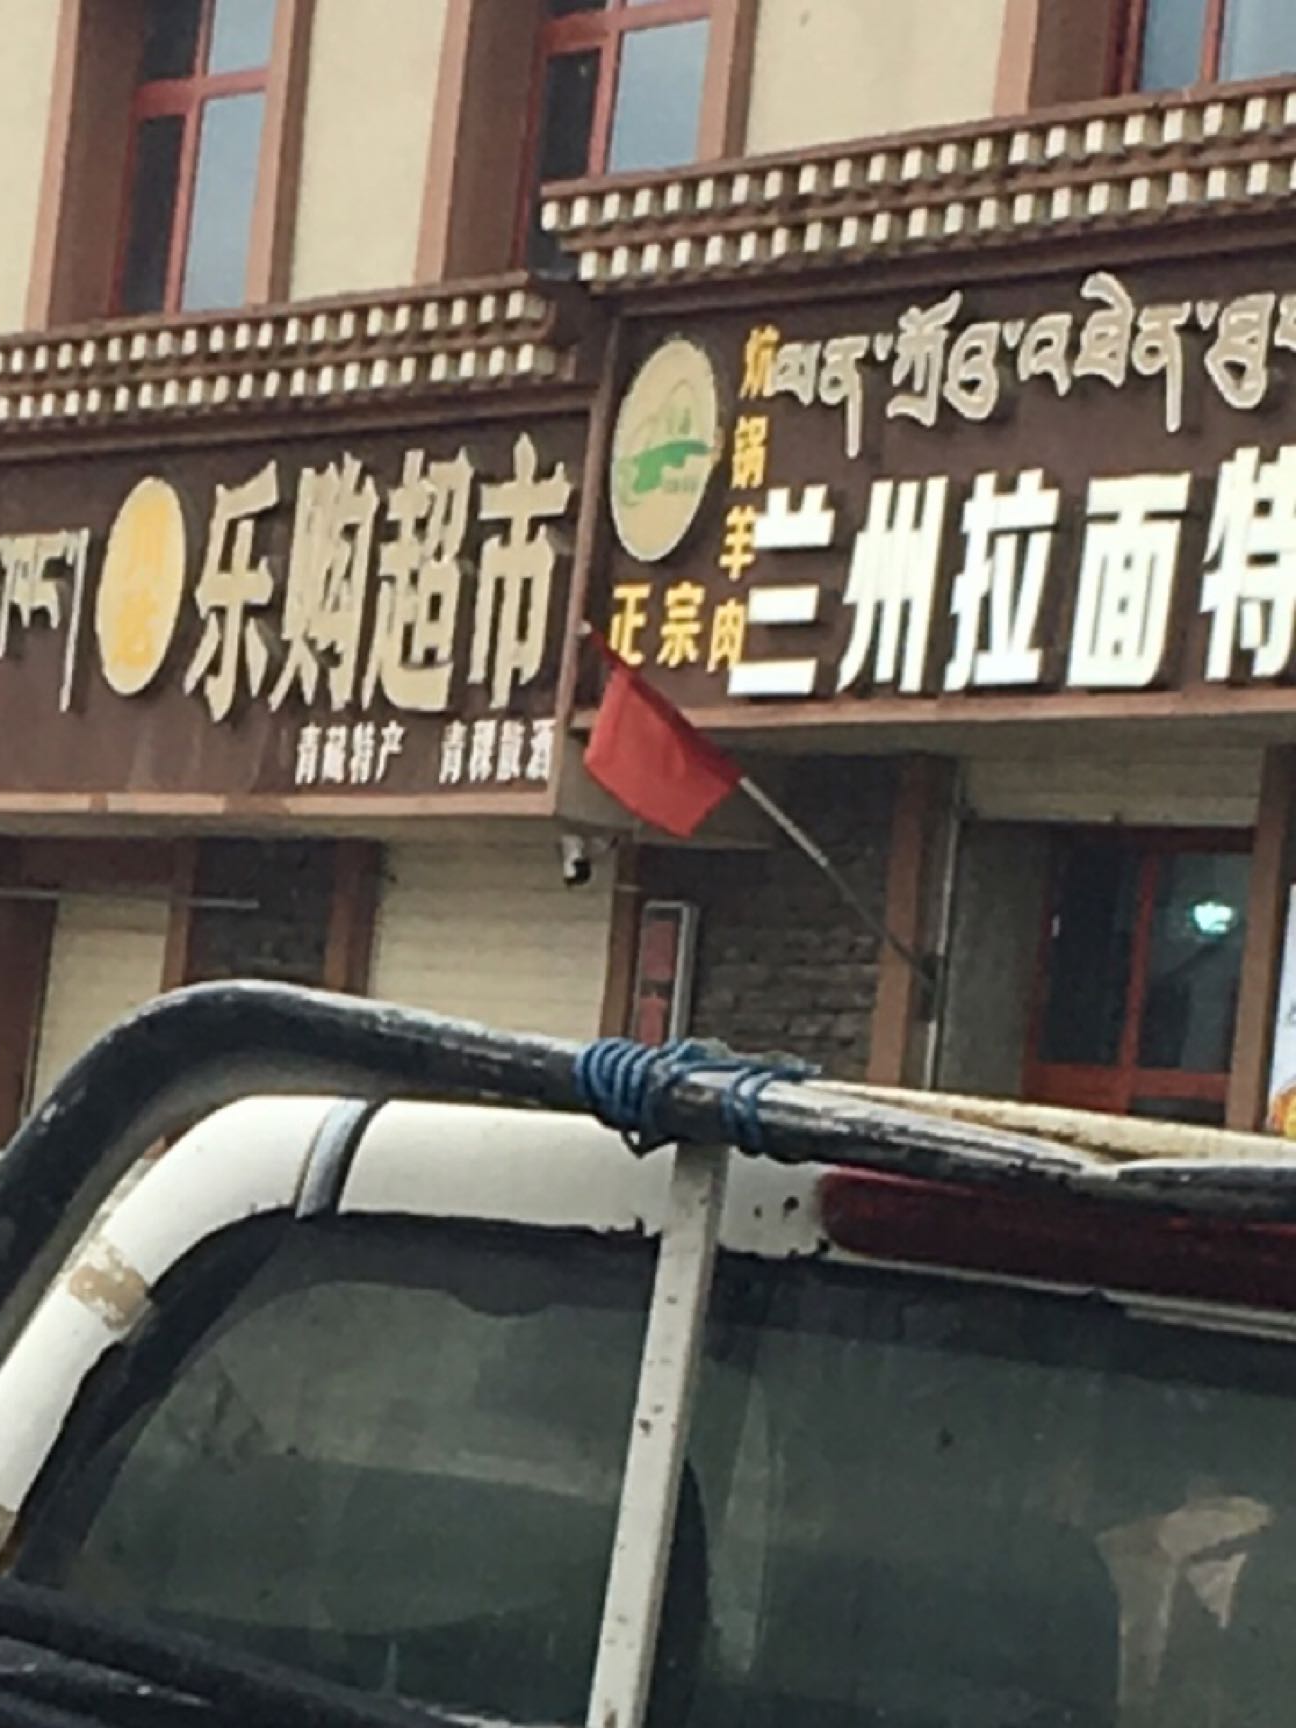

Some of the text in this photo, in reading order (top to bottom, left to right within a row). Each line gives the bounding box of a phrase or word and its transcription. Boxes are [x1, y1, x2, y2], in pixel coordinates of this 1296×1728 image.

[183, 432, 571, 722] 乐购超市
[609, 582, 707, 668] 正宗
[728, 445, 1296, 697] 兰州拉面特
